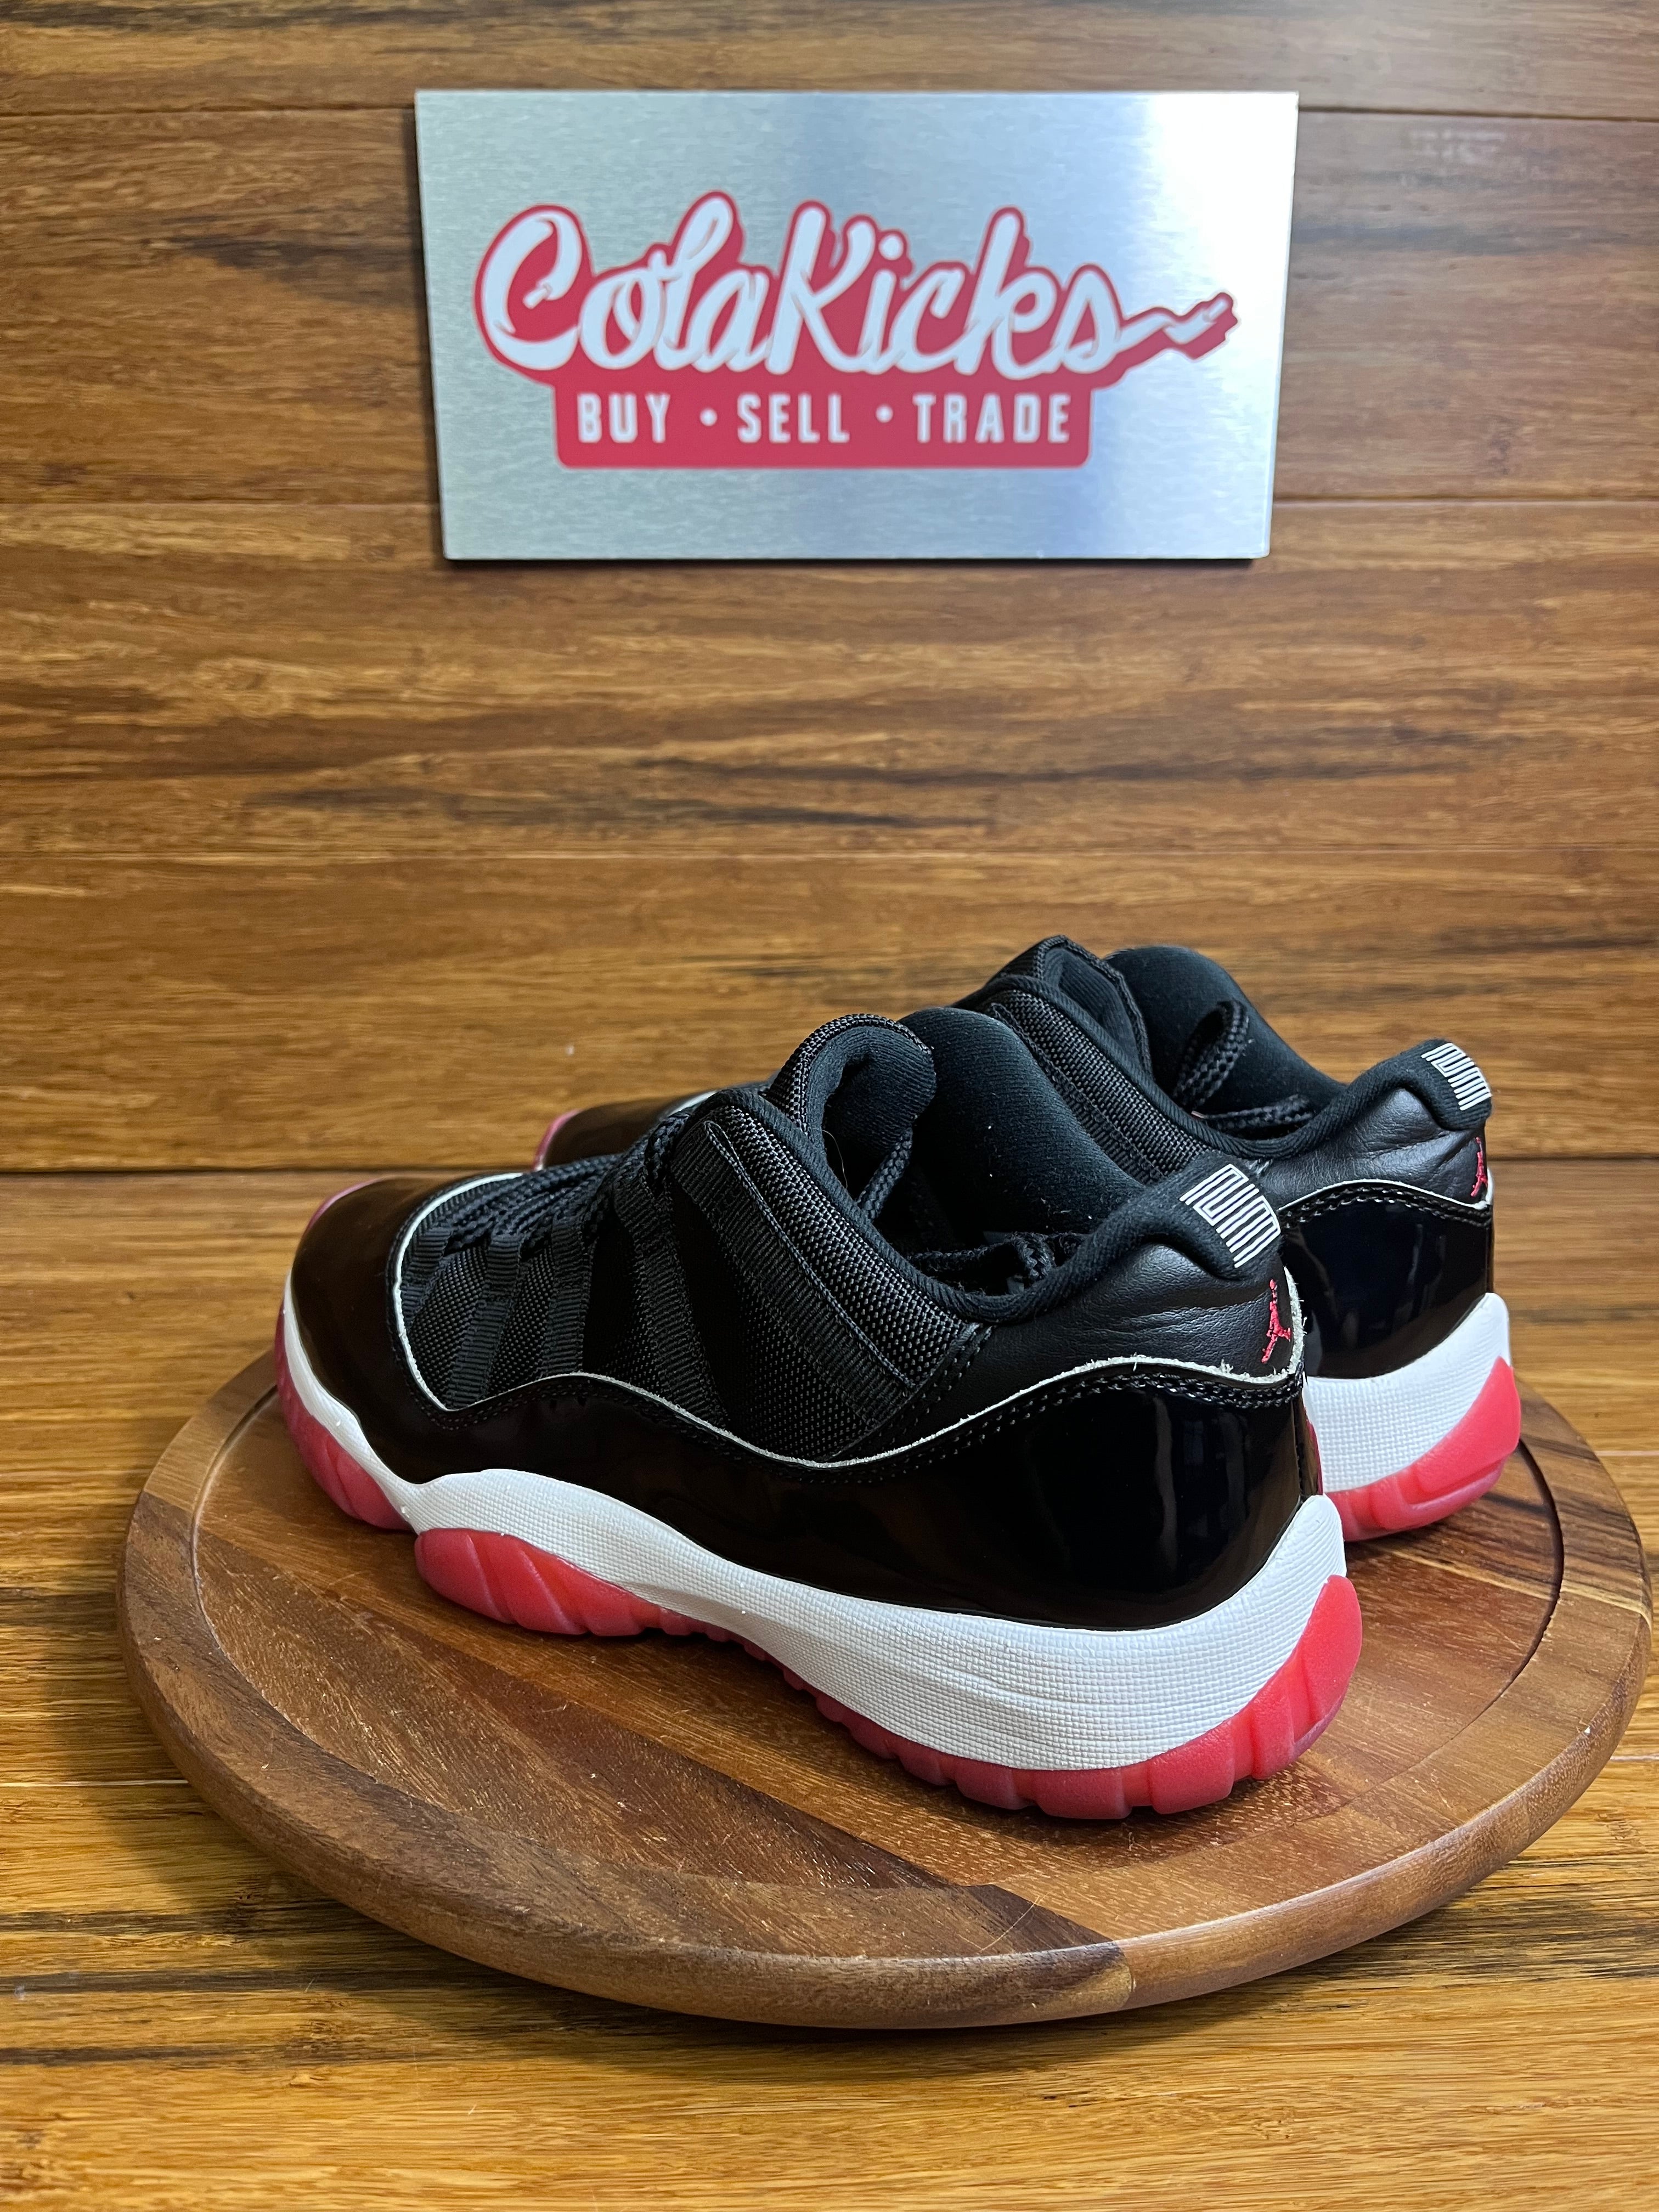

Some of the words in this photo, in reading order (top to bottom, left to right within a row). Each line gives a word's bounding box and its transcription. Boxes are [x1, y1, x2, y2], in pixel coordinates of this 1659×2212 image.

[577, 392, 671, 444] BUY
[736, 392, 851, 444] SELL
[912, 392, 1071, 444] TRADE
